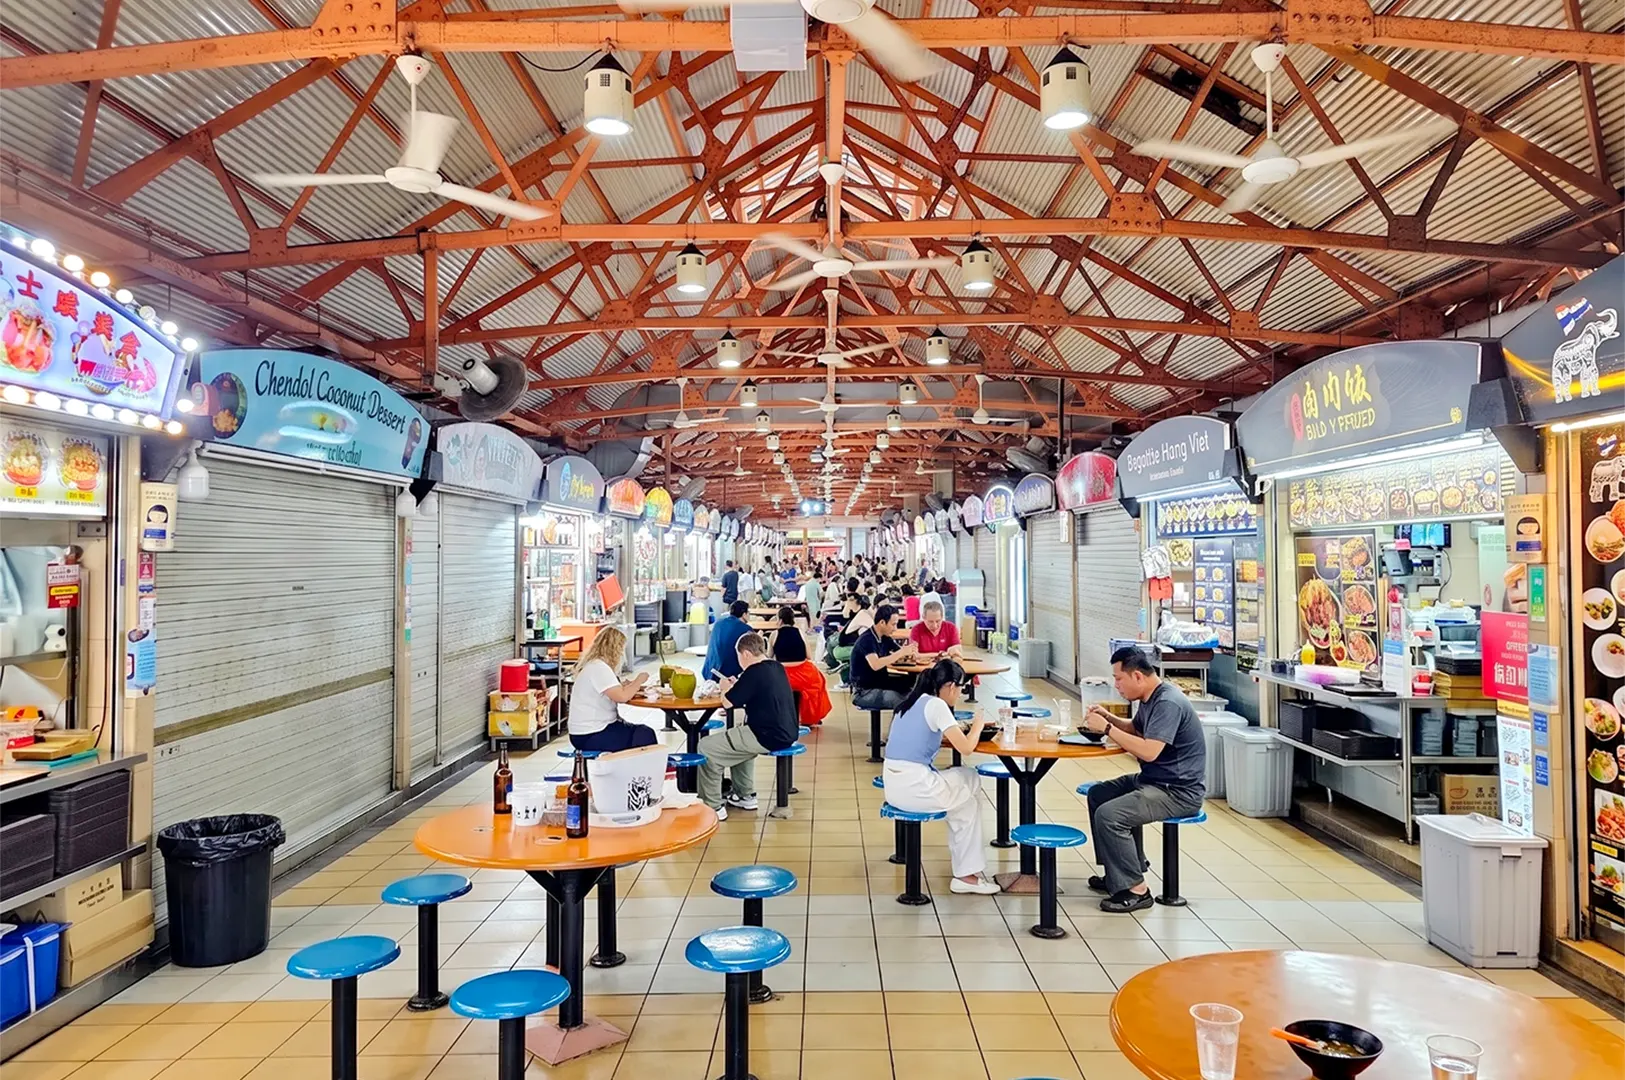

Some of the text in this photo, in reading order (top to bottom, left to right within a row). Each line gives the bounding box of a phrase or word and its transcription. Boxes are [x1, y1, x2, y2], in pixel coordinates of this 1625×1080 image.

[255, 360, 406, 434] Chendol Coconut Dessert
[1161, 442, 1188, 463] Hang
[1188, 430, 1210, 454] Viet
